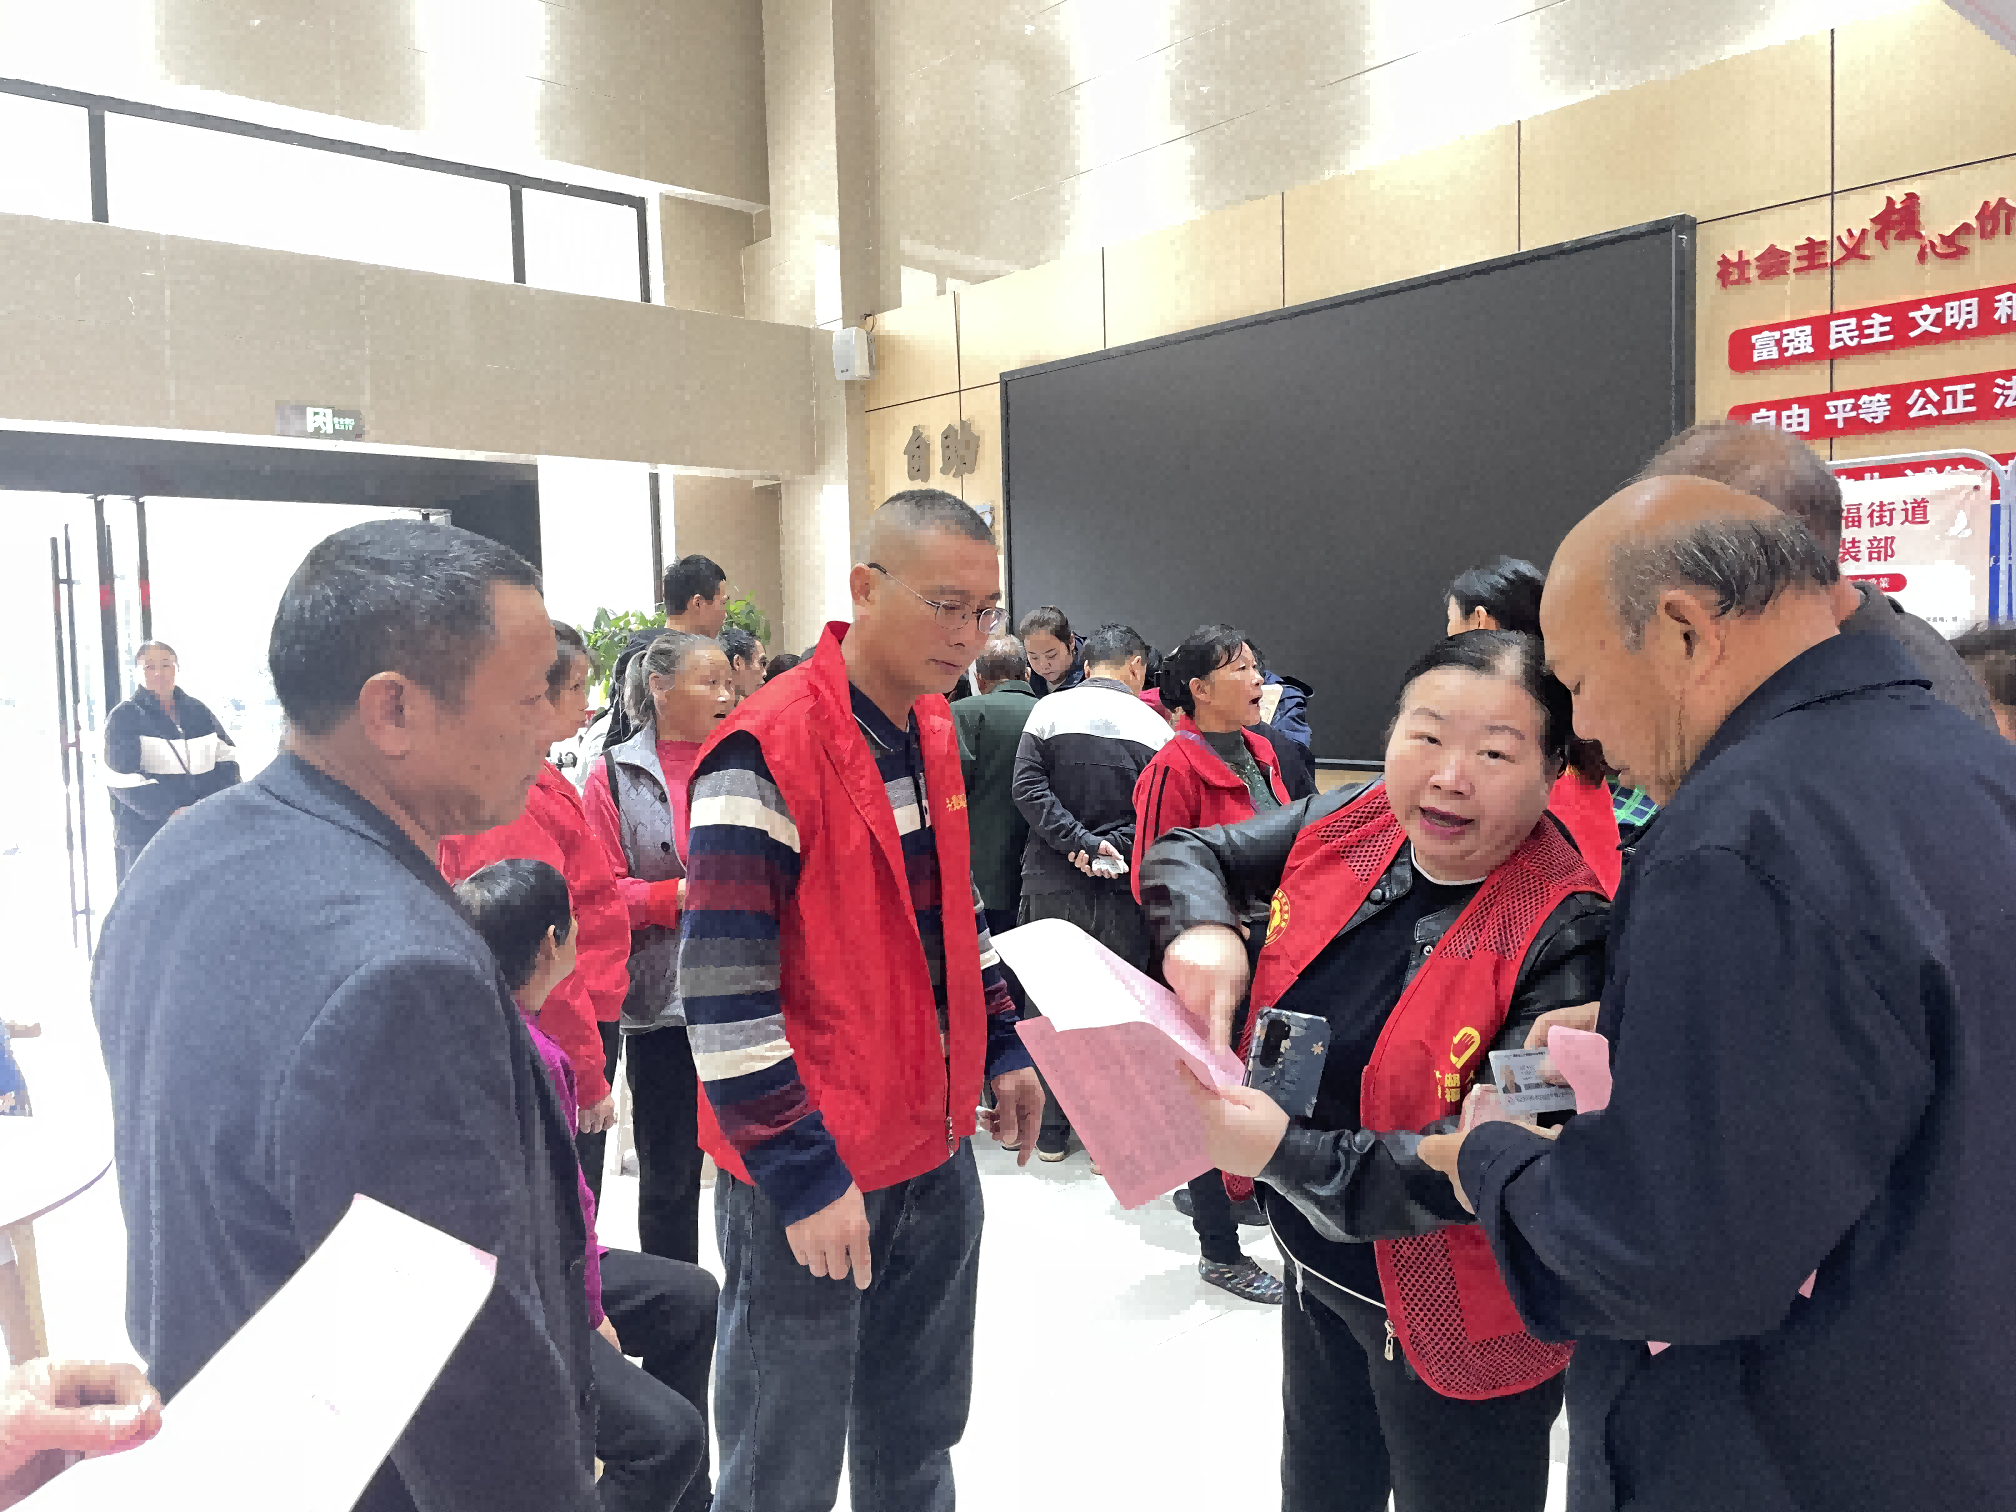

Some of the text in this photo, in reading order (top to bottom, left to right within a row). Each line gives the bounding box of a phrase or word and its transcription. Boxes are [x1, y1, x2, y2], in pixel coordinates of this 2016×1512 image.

[1751, 325, 1814, 362] 富强
[1829, 313, 1893, 349] 民主
[1908, 297, 1979, 337] 文明
[1824, 393, 1891, 428] 平等
[1906, 383, 1977, 418] 公正
